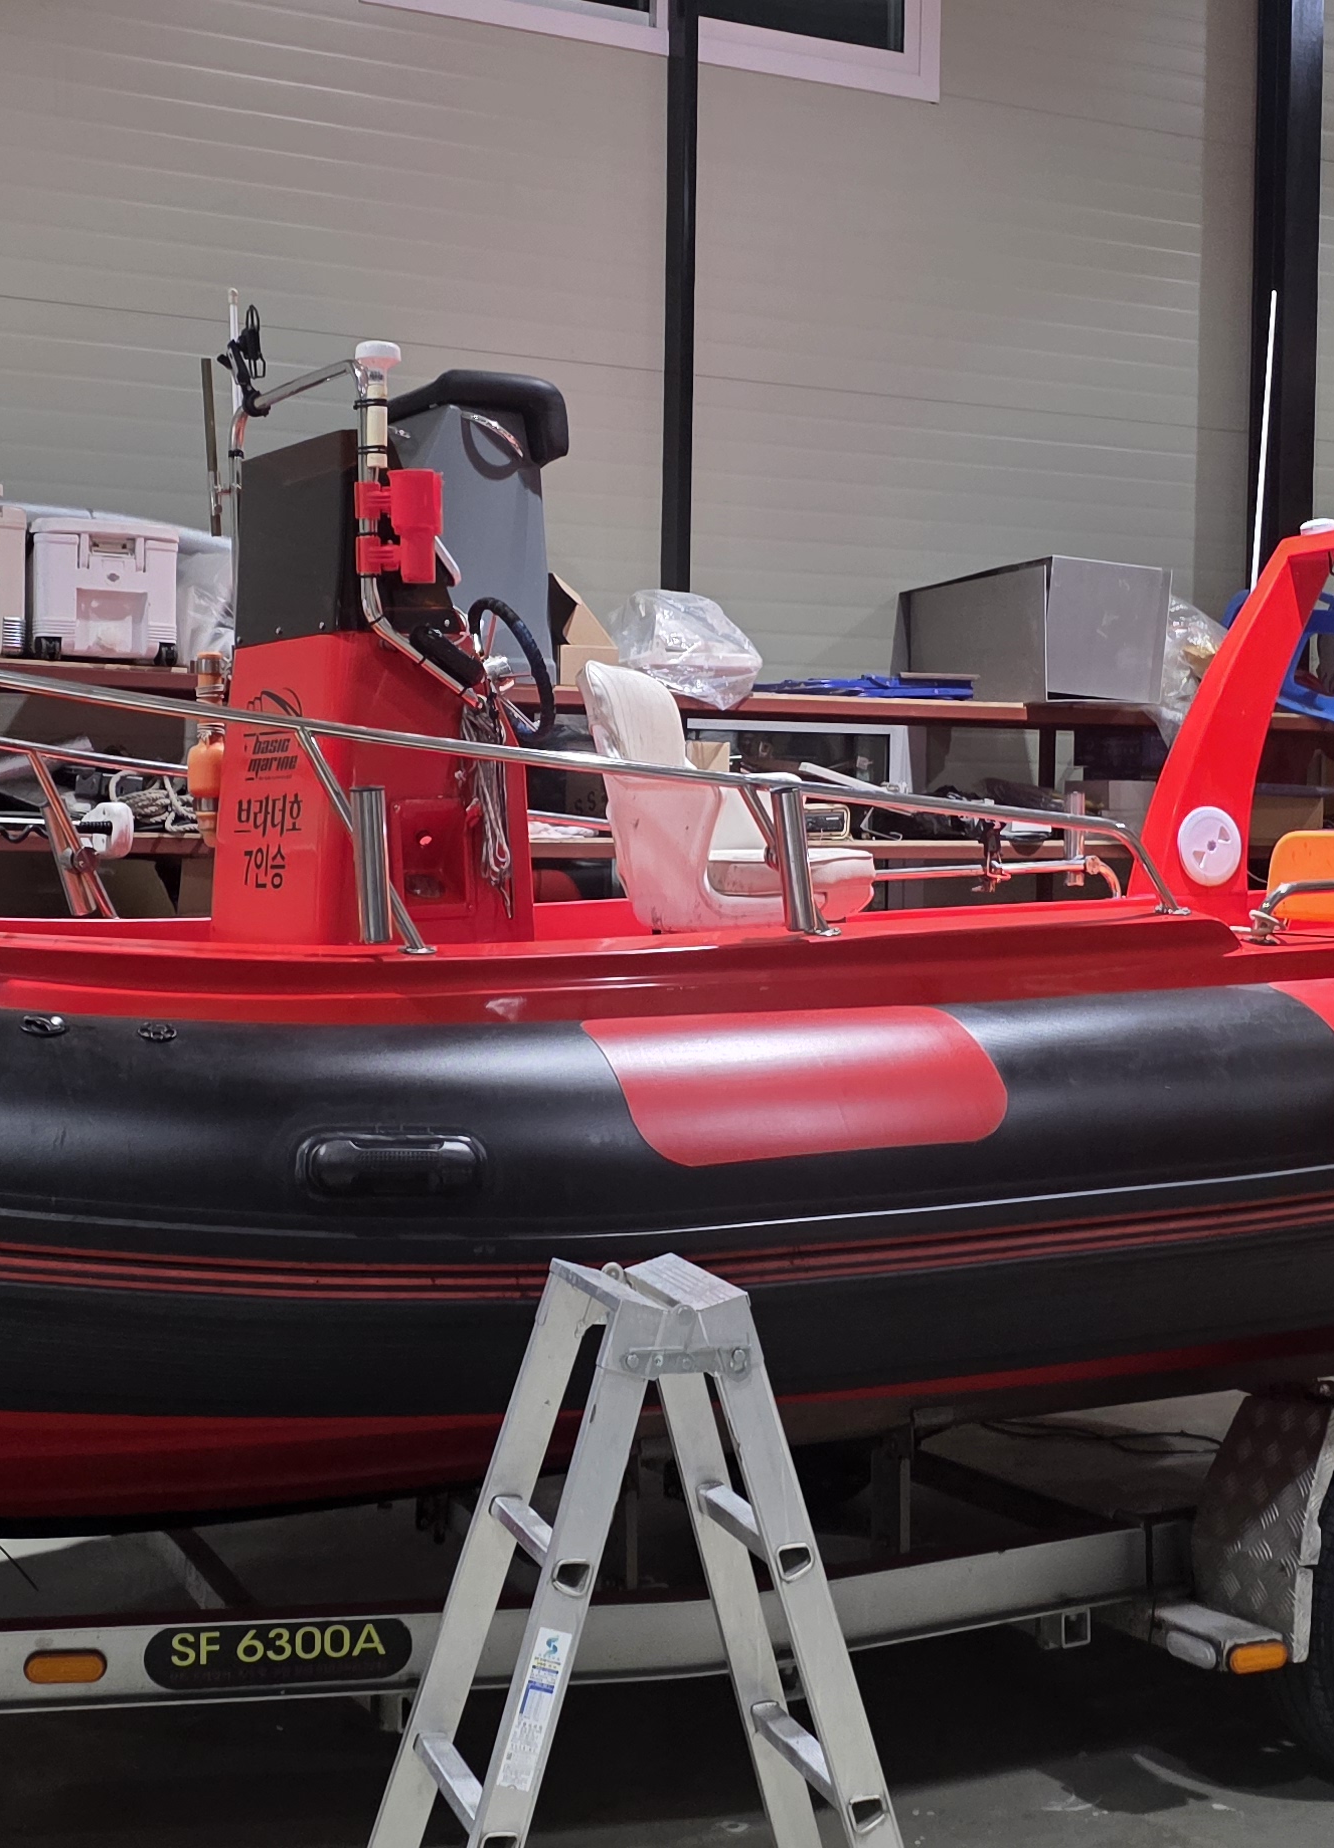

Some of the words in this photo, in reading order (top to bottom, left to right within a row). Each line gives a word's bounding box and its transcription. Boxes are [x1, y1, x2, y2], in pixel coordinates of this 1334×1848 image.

[247, 755, 299, 779] marine
[252, 735, 291, 755] basic
[233, 792, 303, 838] 브라더호
[244, 843, 286, 889] 7인승
[170, 1631, 221, 1667] SF
[236, 1623, 386, 1663] 6300A
